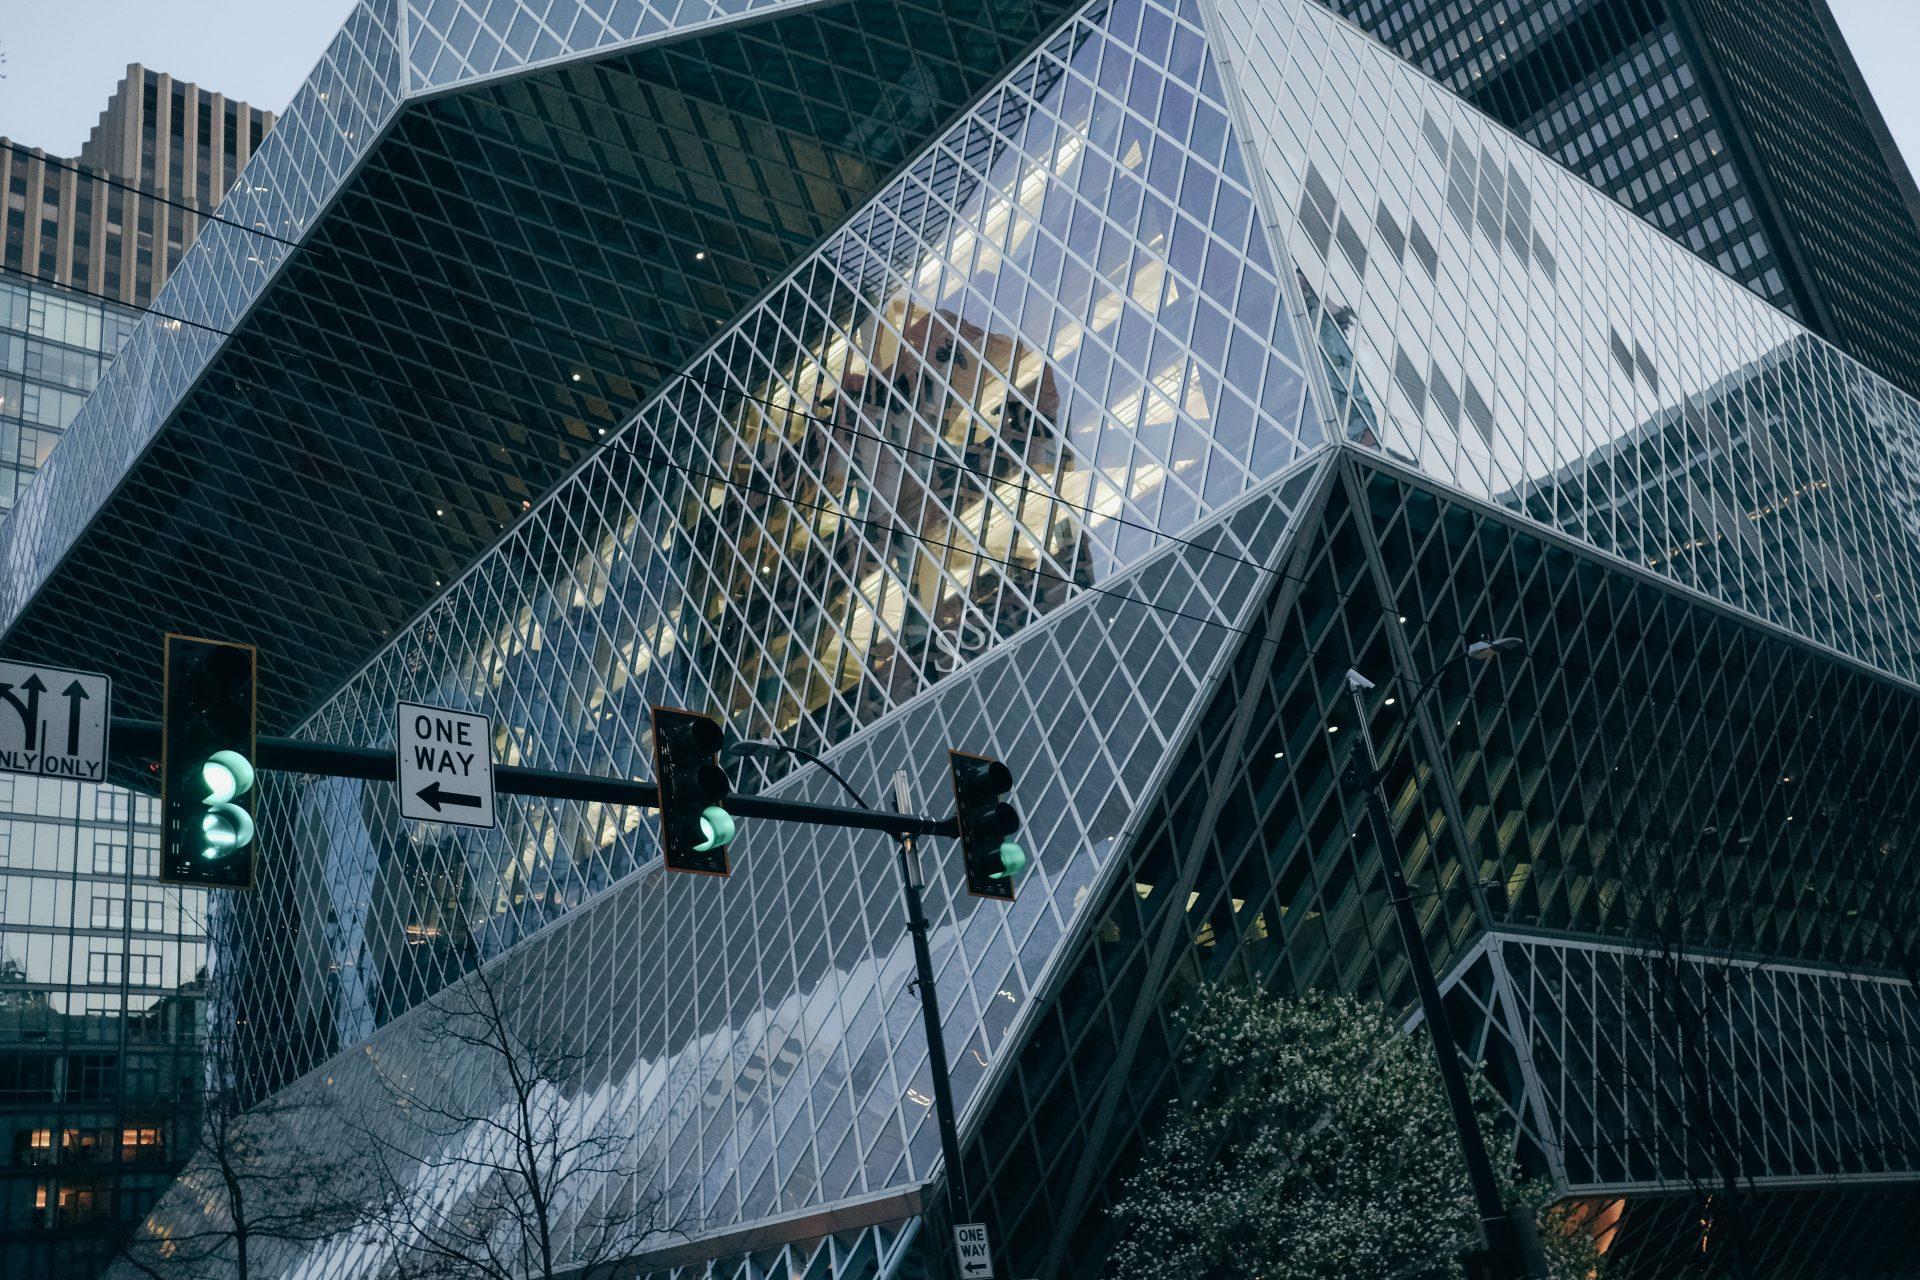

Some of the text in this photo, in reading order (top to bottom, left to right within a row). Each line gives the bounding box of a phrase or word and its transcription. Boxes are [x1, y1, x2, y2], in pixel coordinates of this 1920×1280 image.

[415, 714, 472, 746] ONE
[0, 750, 38, 770] NLY
[45, 756, 100, 777] ONLY
[415, 745, 475, 777] WAY
[959, 1228, 985, 1242] ONE
[960, 1243, 986, 1257] WAY
